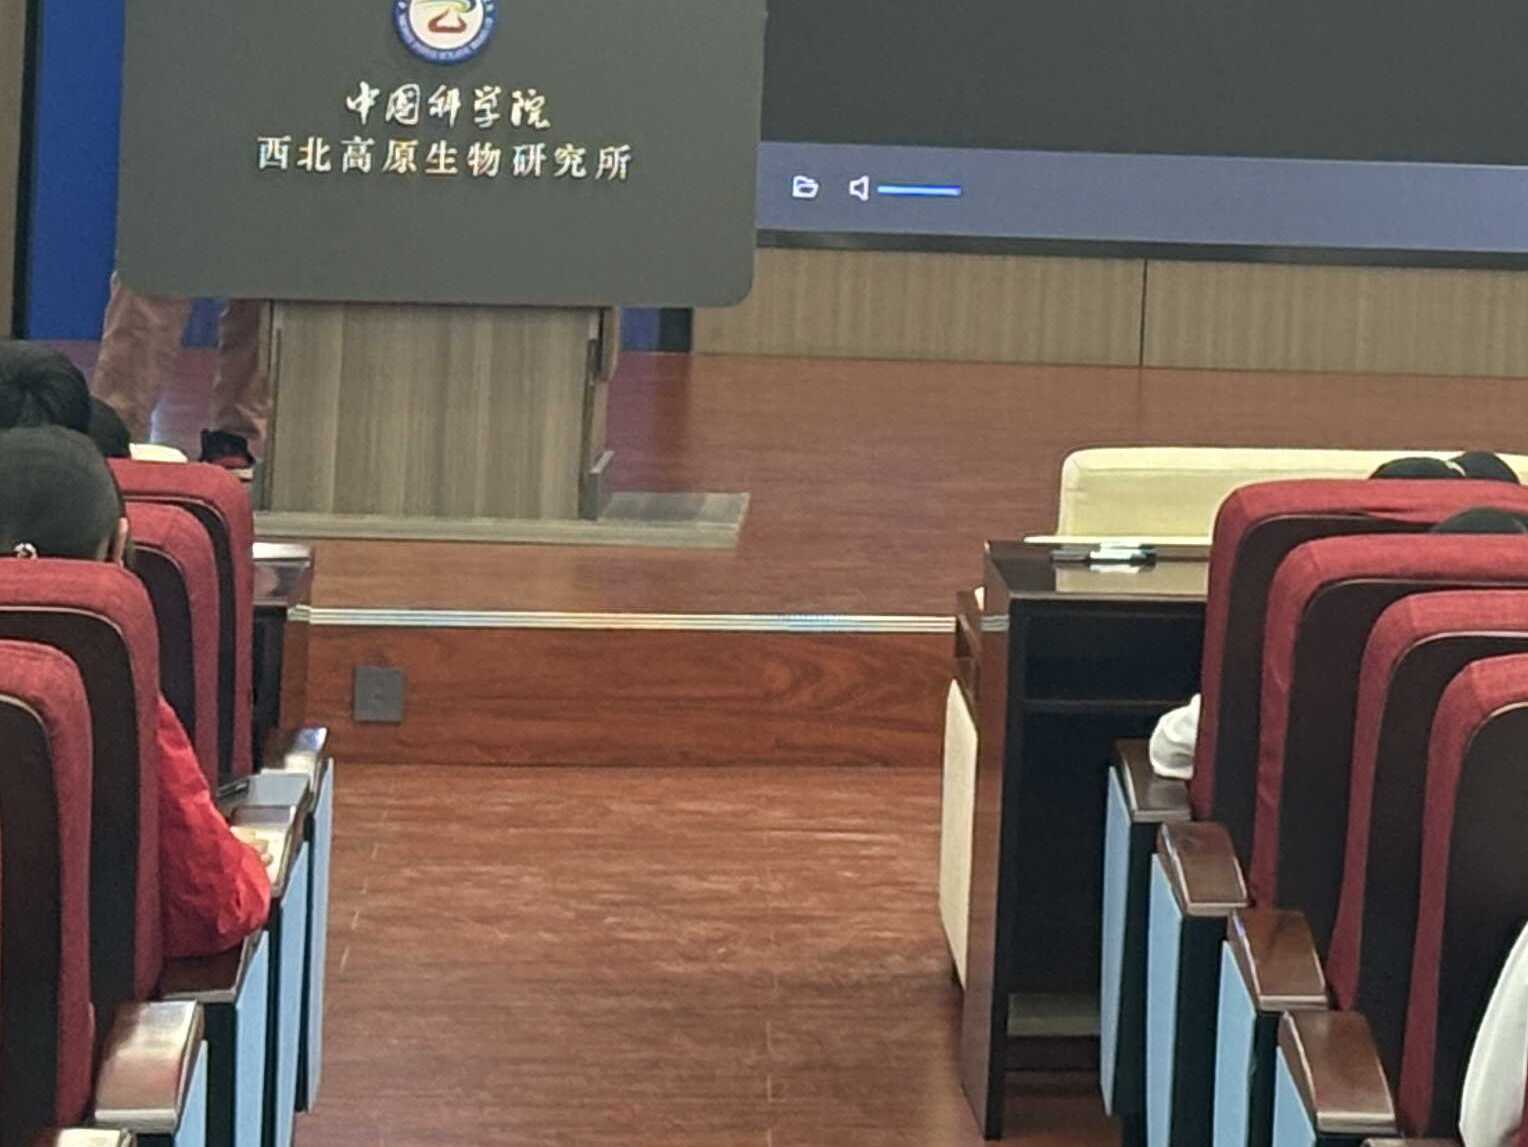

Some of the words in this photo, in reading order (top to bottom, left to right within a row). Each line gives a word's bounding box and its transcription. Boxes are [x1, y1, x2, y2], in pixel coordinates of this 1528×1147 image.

[345, 81, 552, 130] 中国科学院
[256, 135, 633, 182] 西北高原生物研究所
